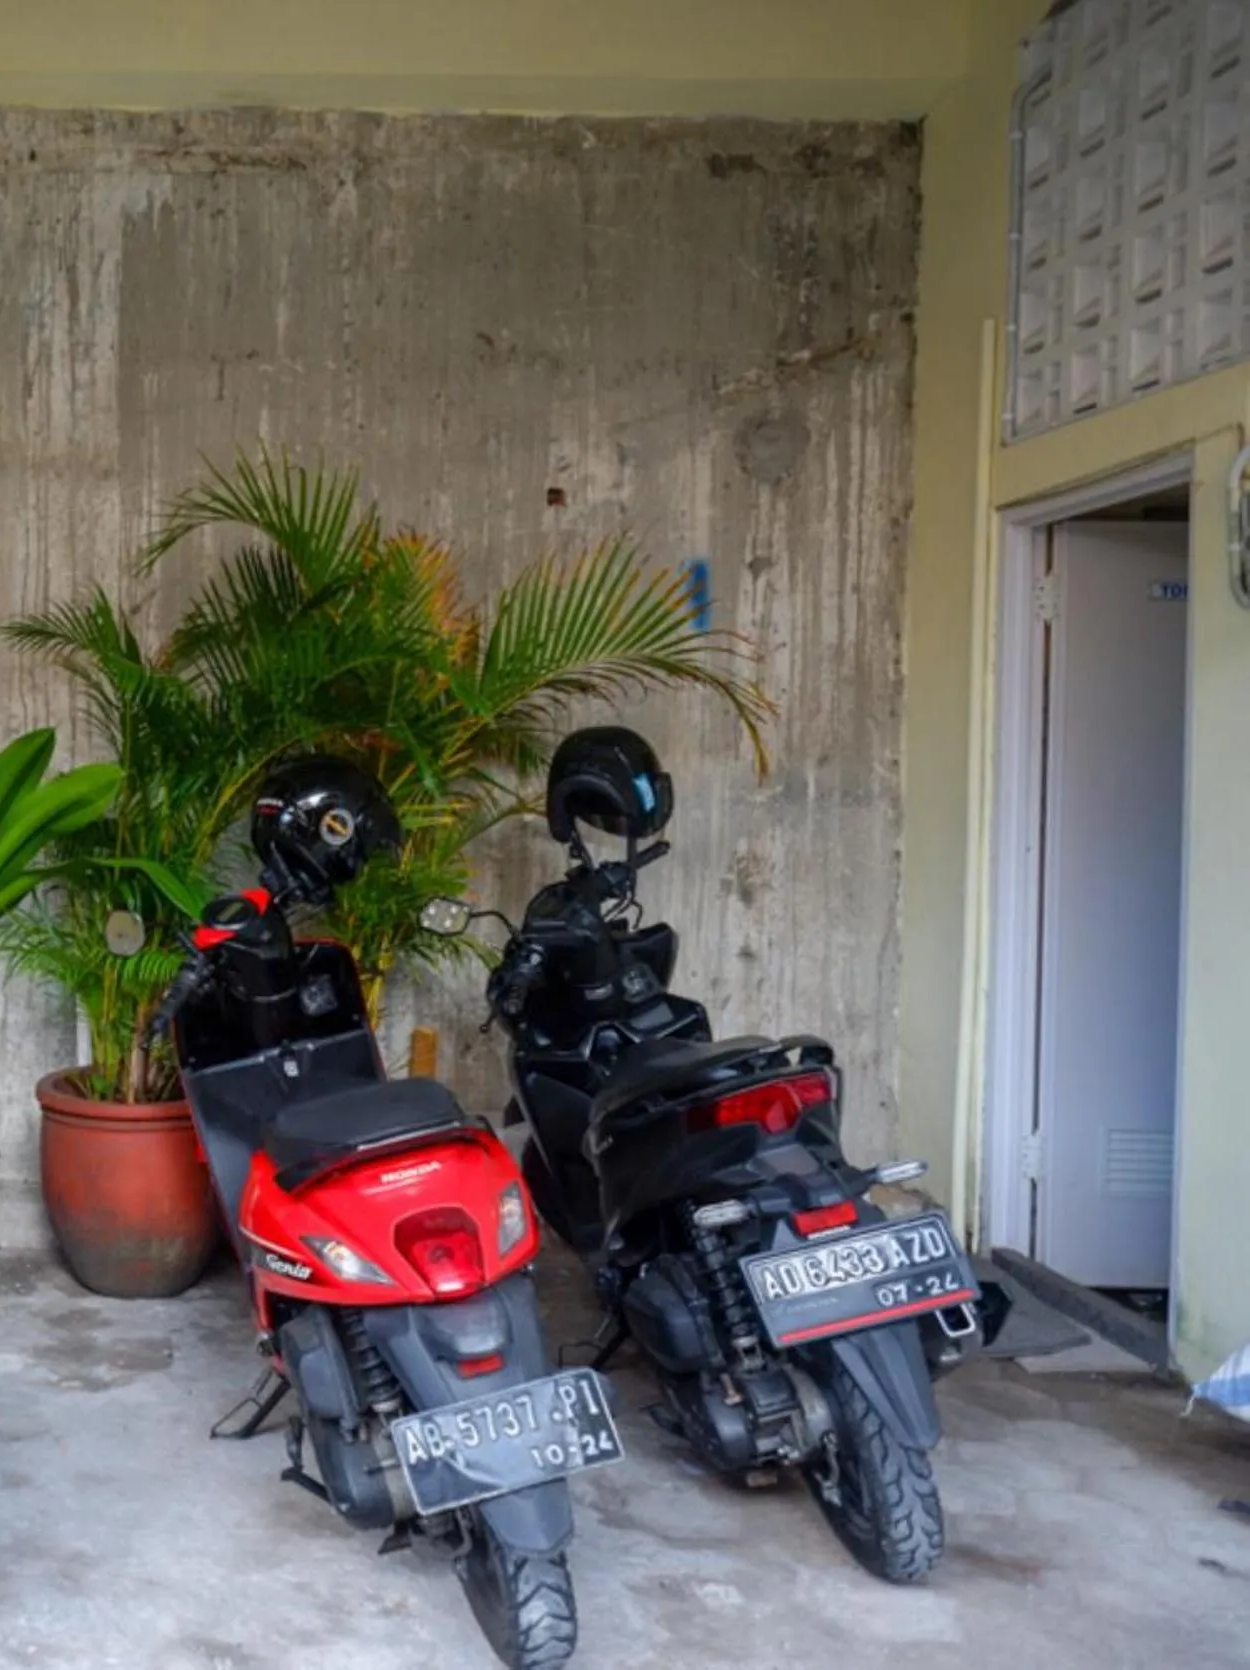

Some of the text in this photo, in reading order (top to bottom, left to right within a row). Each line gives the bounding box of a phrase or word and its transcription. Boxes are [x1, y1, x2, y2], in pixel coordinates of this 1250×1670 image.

[762, 1226, 946, 1300] AD 6433 AZD
[456, 1395, 538, 1447] 5737
